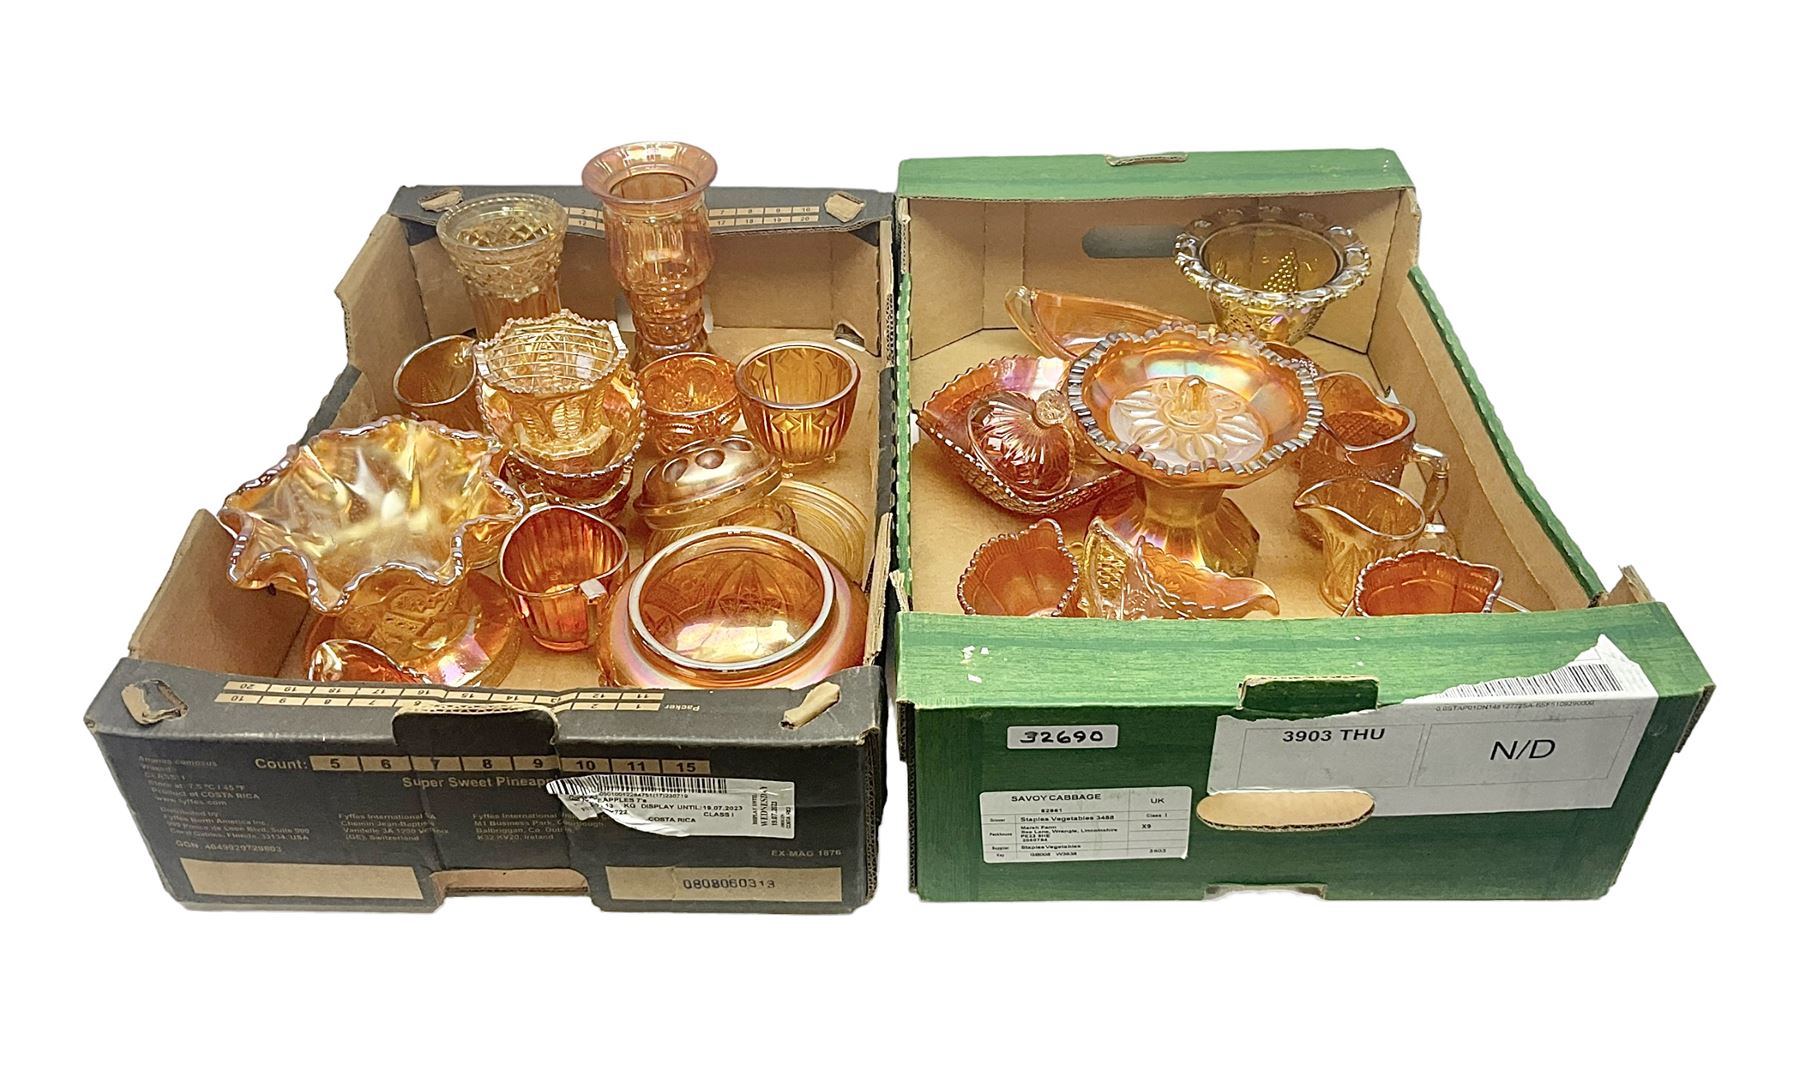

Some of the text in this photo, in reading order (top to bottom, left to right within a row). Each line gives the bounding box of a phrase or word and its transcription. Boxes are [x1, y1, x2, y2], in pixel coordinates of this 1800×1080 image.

[664, 703, 700, 711] Packer
[1019, 730, 1104, 745] 32690
[1282, 728, 1386, 743] 3903 THU
[1490, 739, 1556, 761] N/D
[254, 758, 696, 773] Count: 5 6 7 8 9 10 11 15
[402, 776, 443, 790] Super
[449, 777, 492, 788] Sweet
[200, 791, 234, 799] COSTA
[1011, 793, 1102, 803] SAVOY CABBAGE
[760, 786, 769, 827] WEDNESDAY
[1150, 797, 1165, 805] UK
[1020, 815, 1049, 823] Staples
[1050, 815, 1094, 824] Vegetables
[770, 849, 842, 857] EX-MAG 1876
[682, 879, 776, 890] 0808060313
